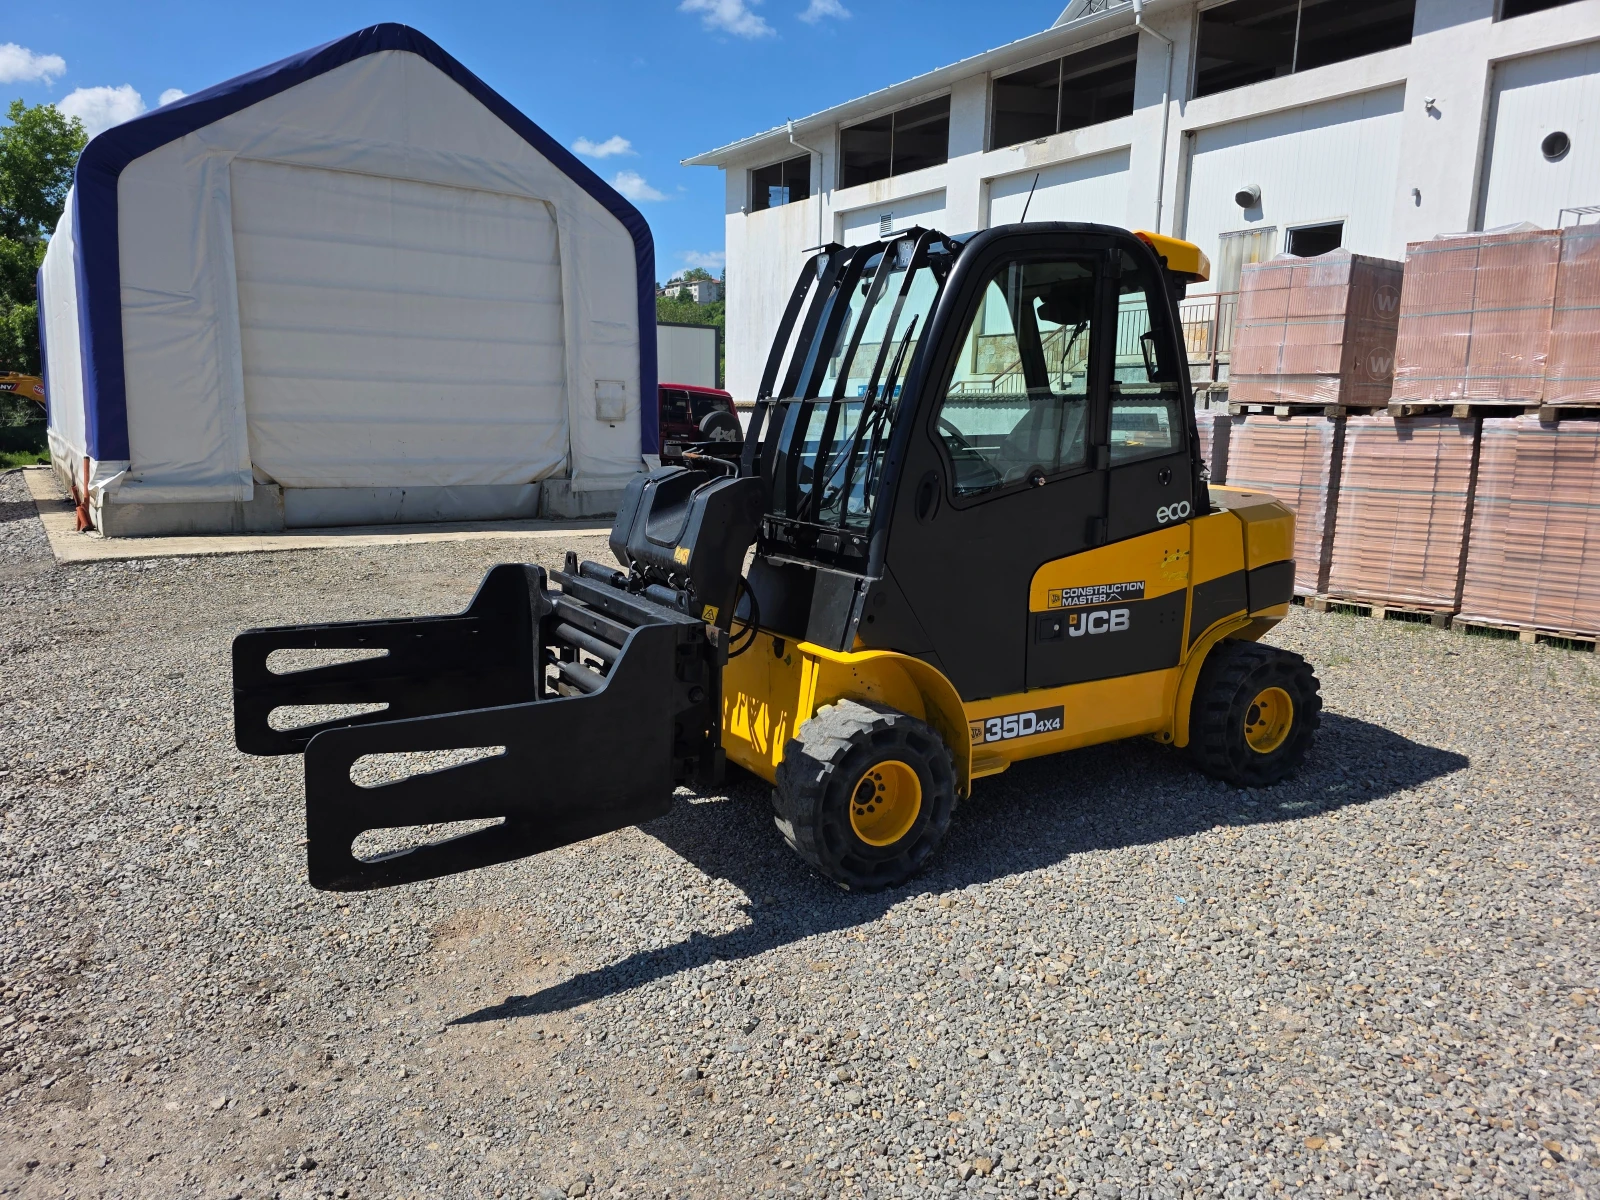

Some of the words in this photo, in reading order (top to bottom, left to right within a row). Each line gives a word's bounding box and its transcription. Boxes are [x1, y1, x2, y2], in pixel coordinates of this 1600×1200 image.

[1377, 294, 1398, 312] W
[1370, 356, 1391, 373] W
[1156, 500, 1190, 523] eco
[1062, 581, 1145, 598] CONSTRUCTION
[1062, 594, 1106, 607] MASTER
[1069, 608, 1130, 637] JCB
[985, 712, 1037, 742] 35D
